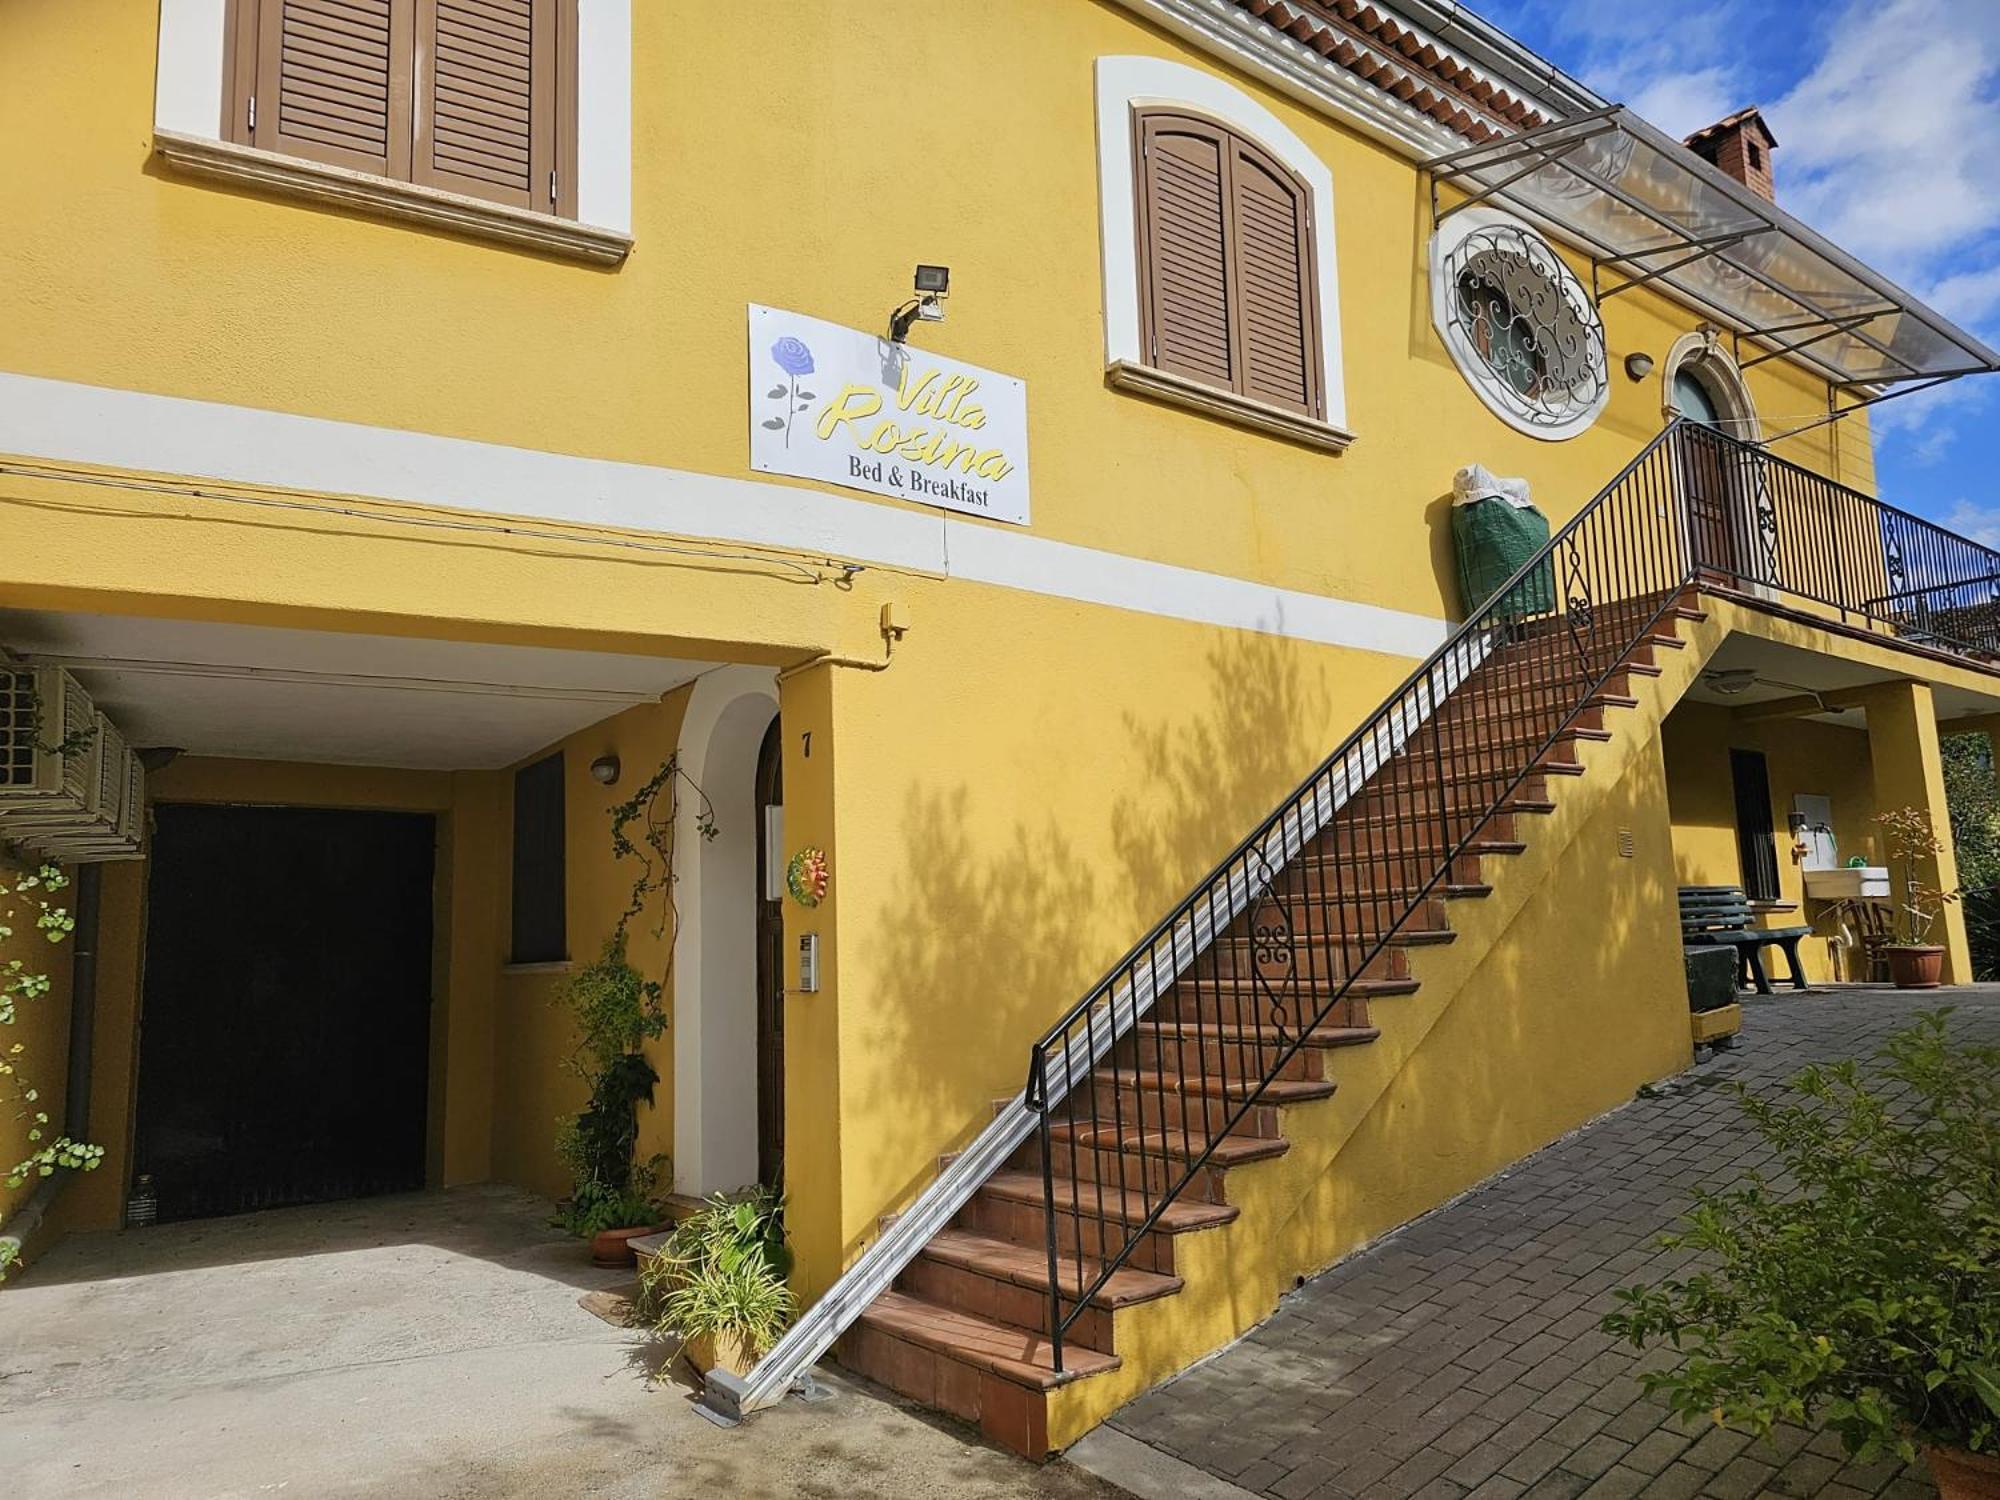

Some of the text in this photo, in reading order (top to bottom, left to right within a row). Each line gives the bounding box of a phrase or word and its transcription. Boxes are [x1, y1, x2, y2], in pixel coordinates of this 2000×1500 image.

[898, 358, 987, 430] Villa
[816, 384, 1014, 481] Rosina
[849, 455, 988, 507] Bed & Breakfast
[801, 732, 812, 758] 7
